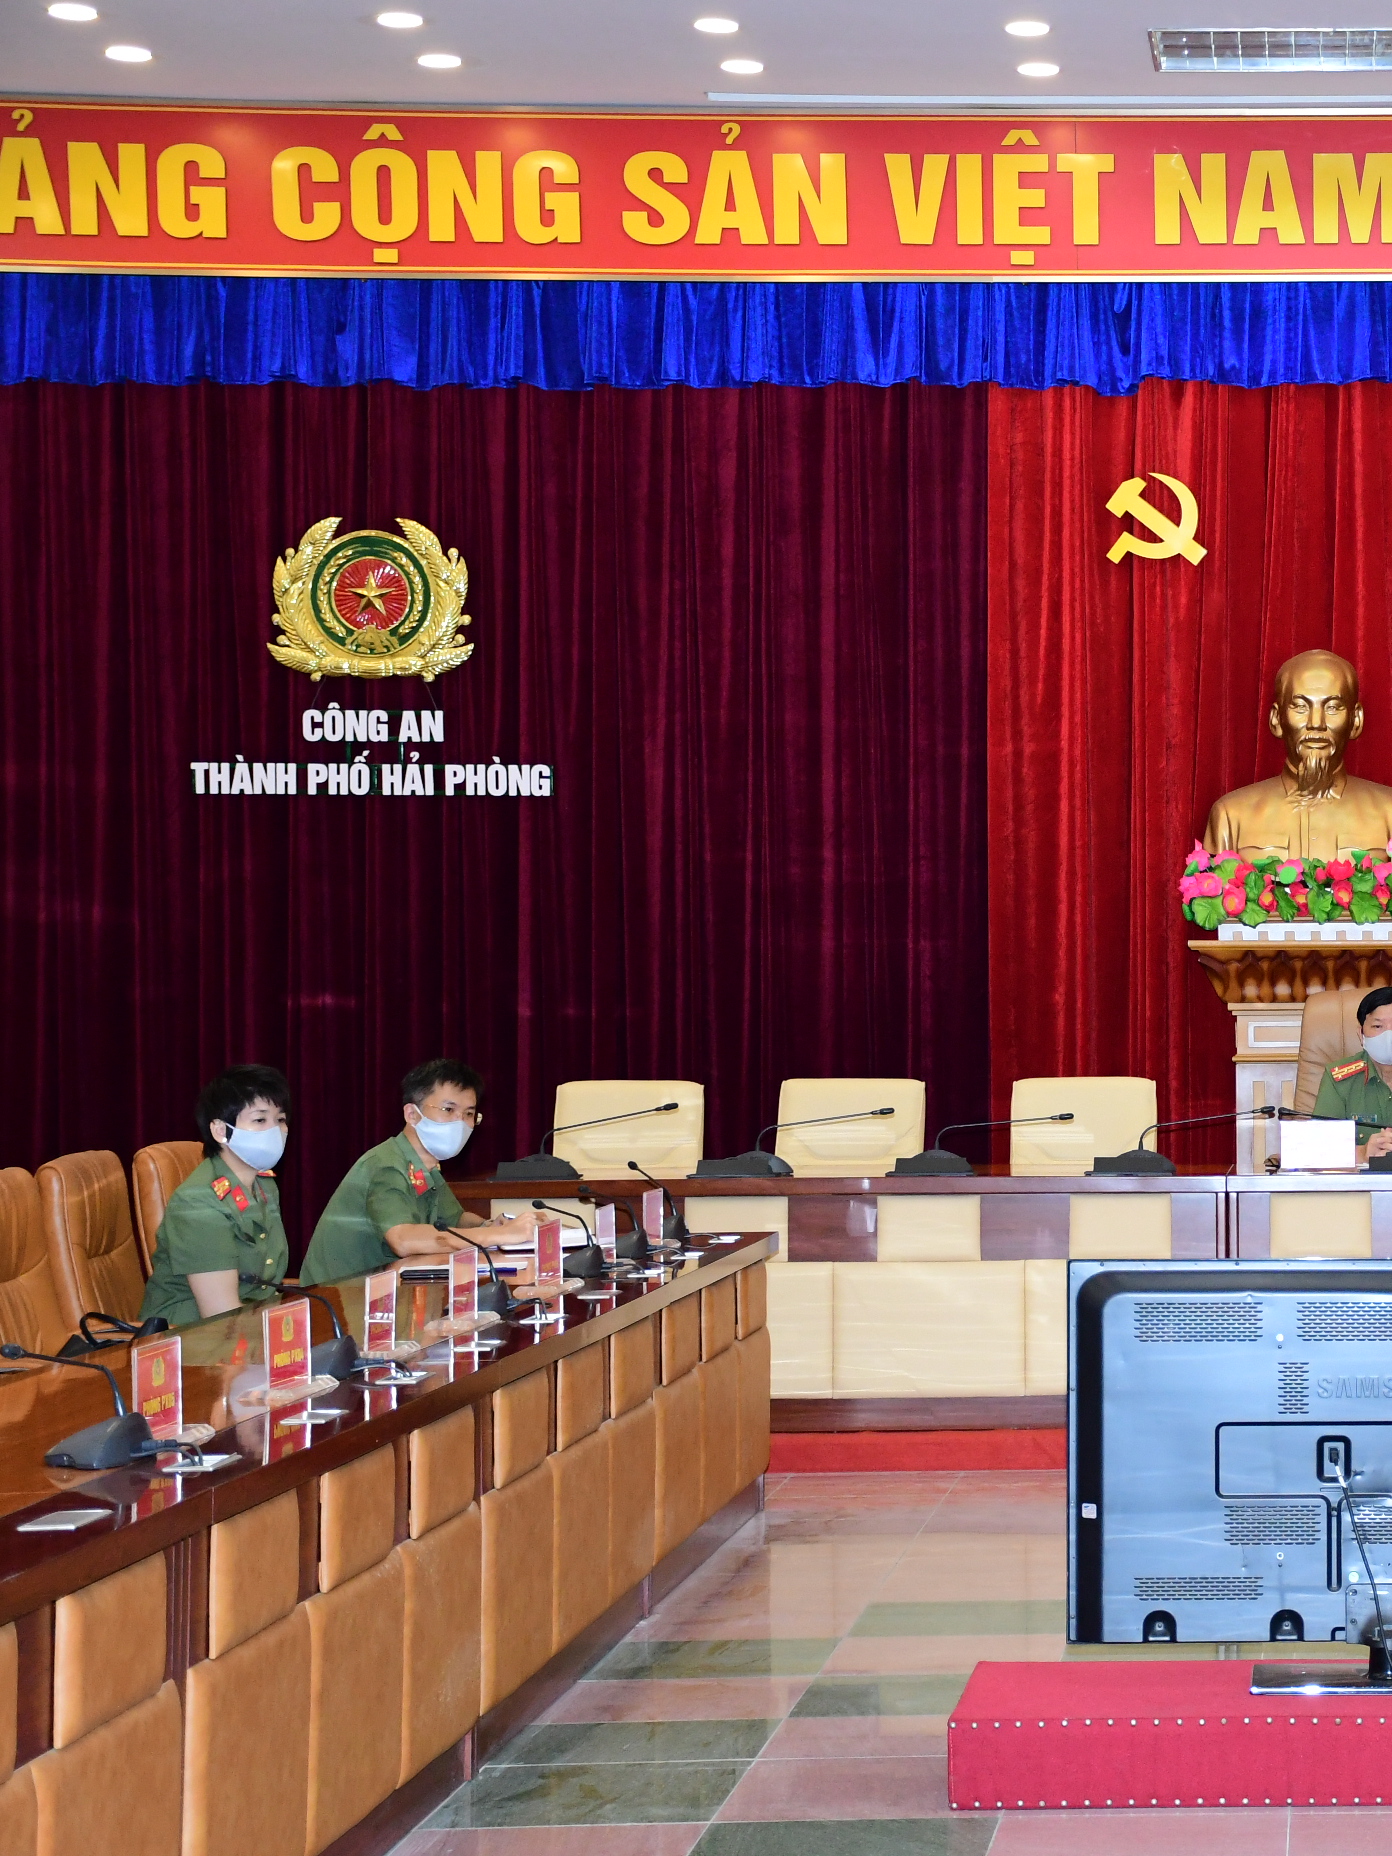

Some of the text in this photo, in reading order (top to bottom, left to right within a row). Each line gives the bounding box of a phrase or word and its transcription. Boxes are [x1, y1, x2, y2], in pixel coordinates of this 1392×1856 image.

[269, 123, 583, 265] CỘNG
[621, 122, 850, 247] SẢN
[883, 129, 1115, 266] VIỆT
[302, 702, 445, 743] CÔNG AN
[190, 749, 552, 798] THÀNH PHỐ HẢI PHÒNG
